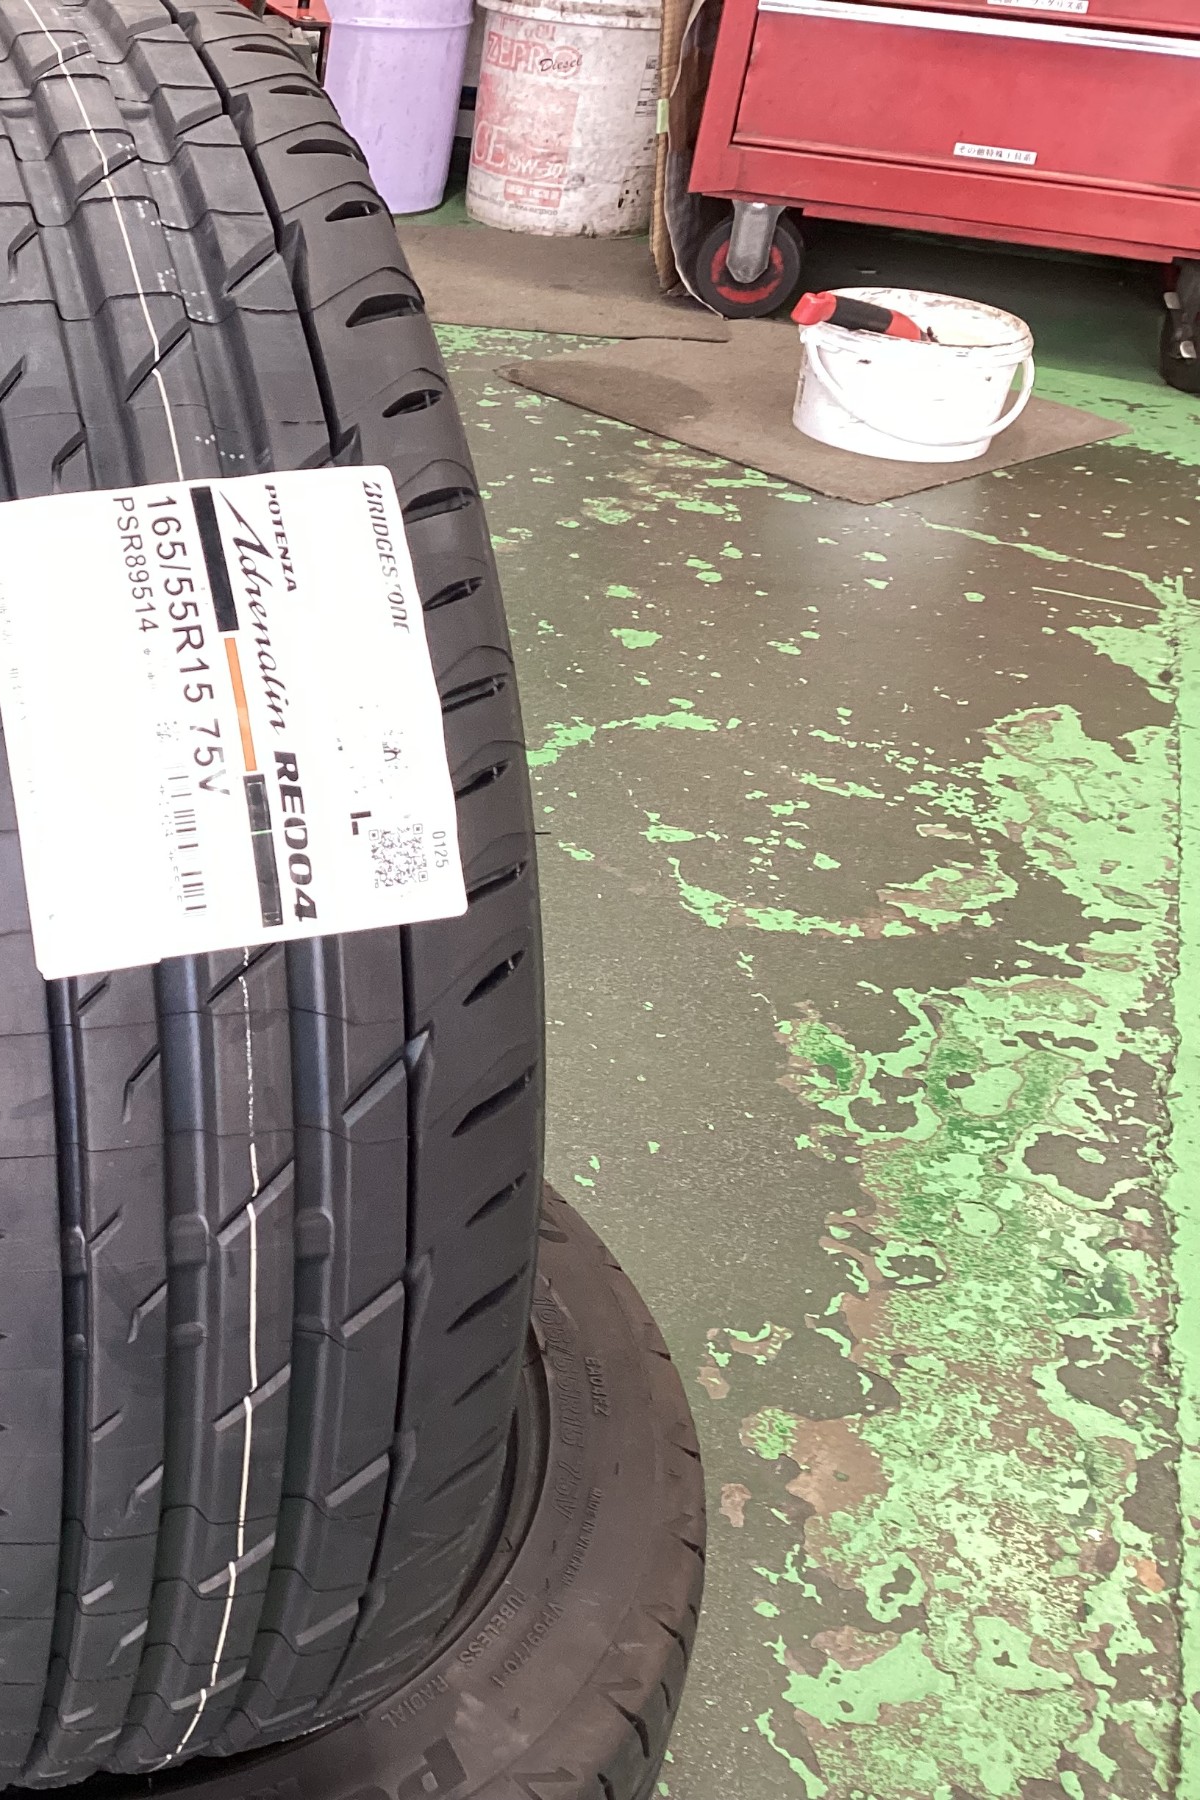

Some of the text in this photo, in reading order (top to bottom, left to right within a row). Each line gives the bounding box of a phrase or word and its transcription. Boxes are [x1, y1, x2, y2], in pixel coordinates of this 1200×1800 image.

[539, 54, 583, 72] Diesel
[112, 496, 159, 634] PSR89514
[264, 483, 298, 593] POTENZA
[147, 496, 231, 797] 165/55R15 75V
[220, 489, 318, 922] Adrenalin RE004
[432, 830, 450, 869] 0125
[380, 1674, 449, 1729] RADIAL
